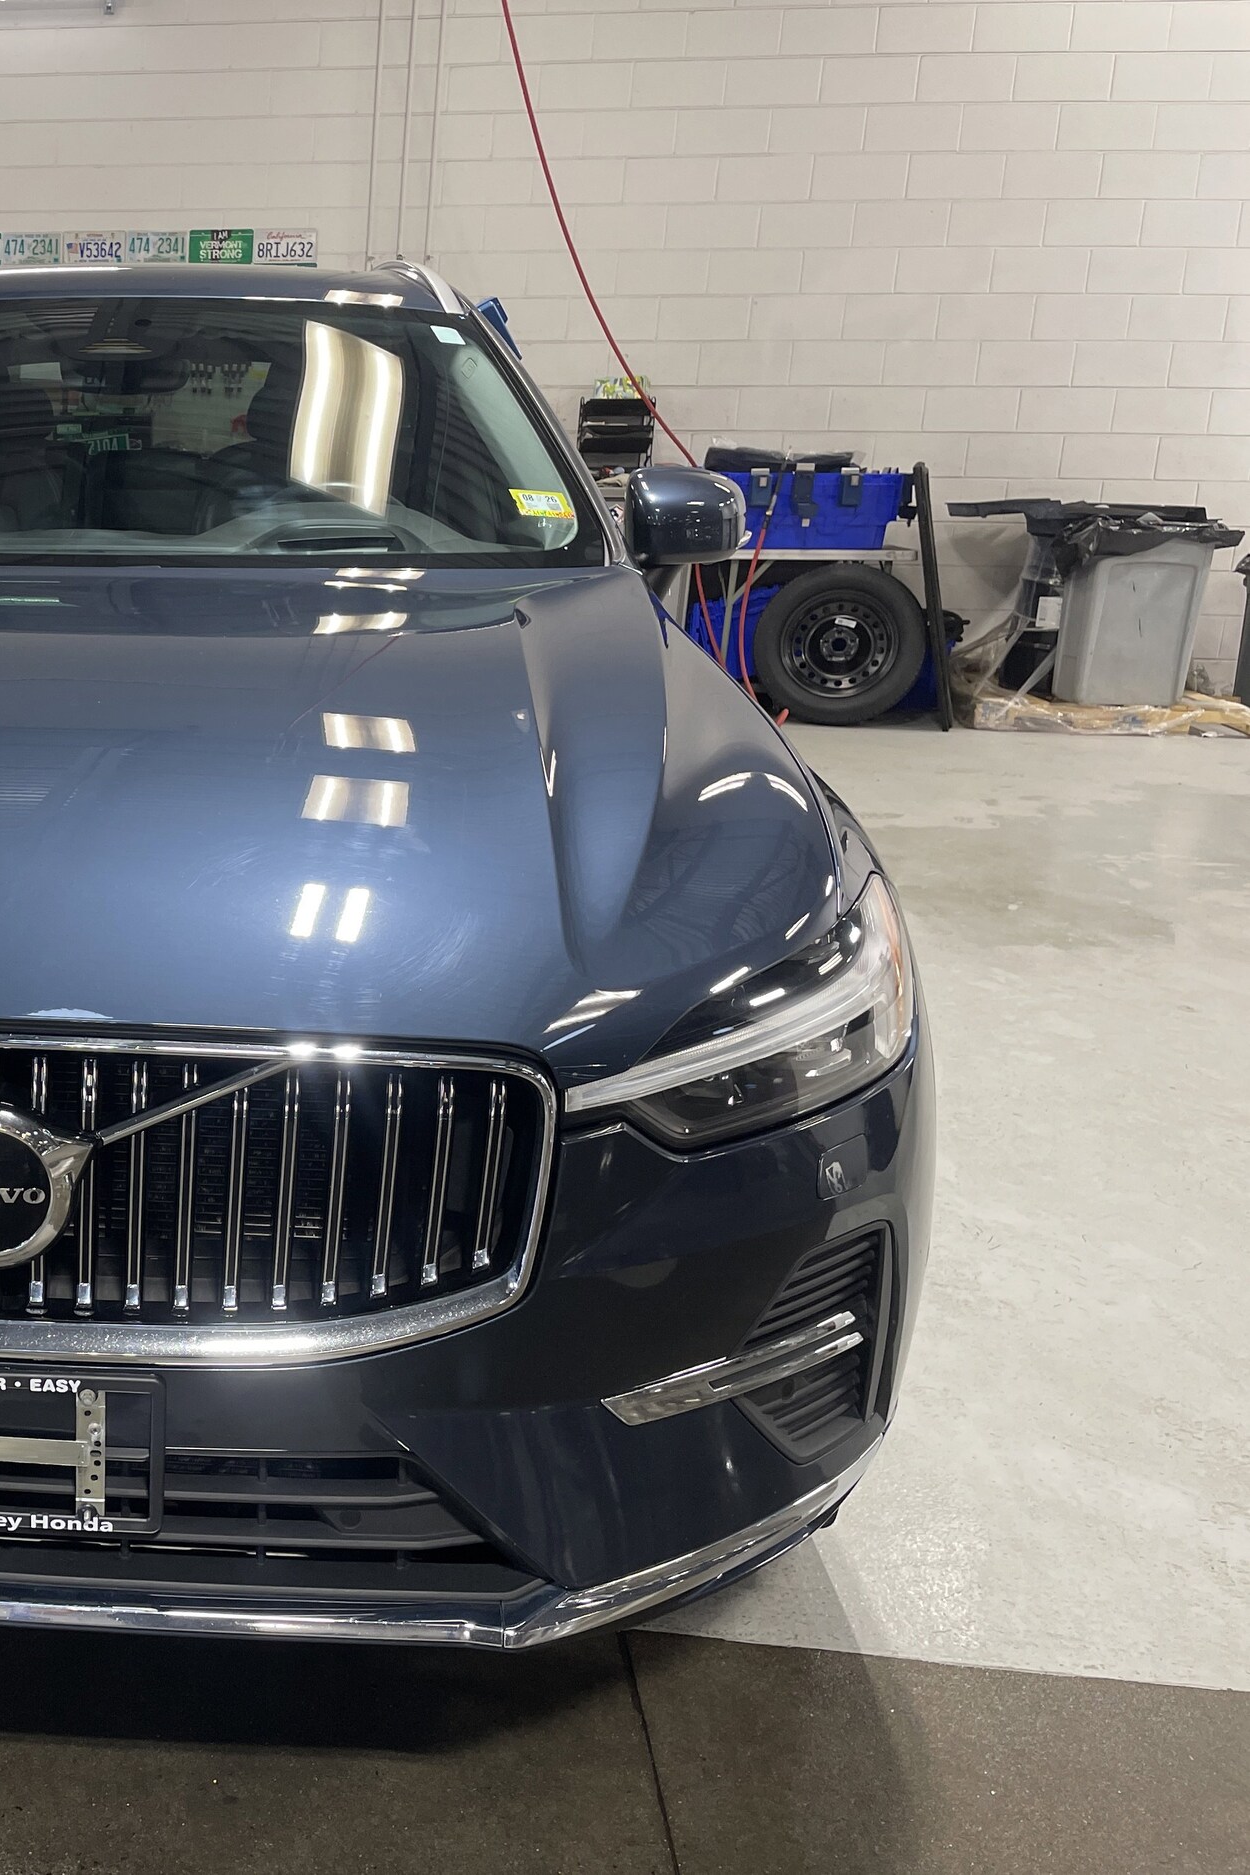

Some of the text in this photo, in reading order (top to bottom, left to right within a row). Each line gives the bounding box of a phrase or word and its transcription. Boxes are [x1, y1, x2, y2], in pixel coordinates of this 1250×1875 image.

[218, 230, 229, 240] AM
[4, 238, 59, 256] 474 2341
[78, 241, 123, 258] V53642
[129, 237, 185, 254] 474 2341
[199, 240, 243, 249] VERMONT
[257, 241, 314, 258] 8RIJ632
[199, 249, 243, 260] STRONG
[521, 493, 558, 503] 08 26
[28, 1377, 82, 1394] EASY
[30, 1513, 115, 1533] Honda
